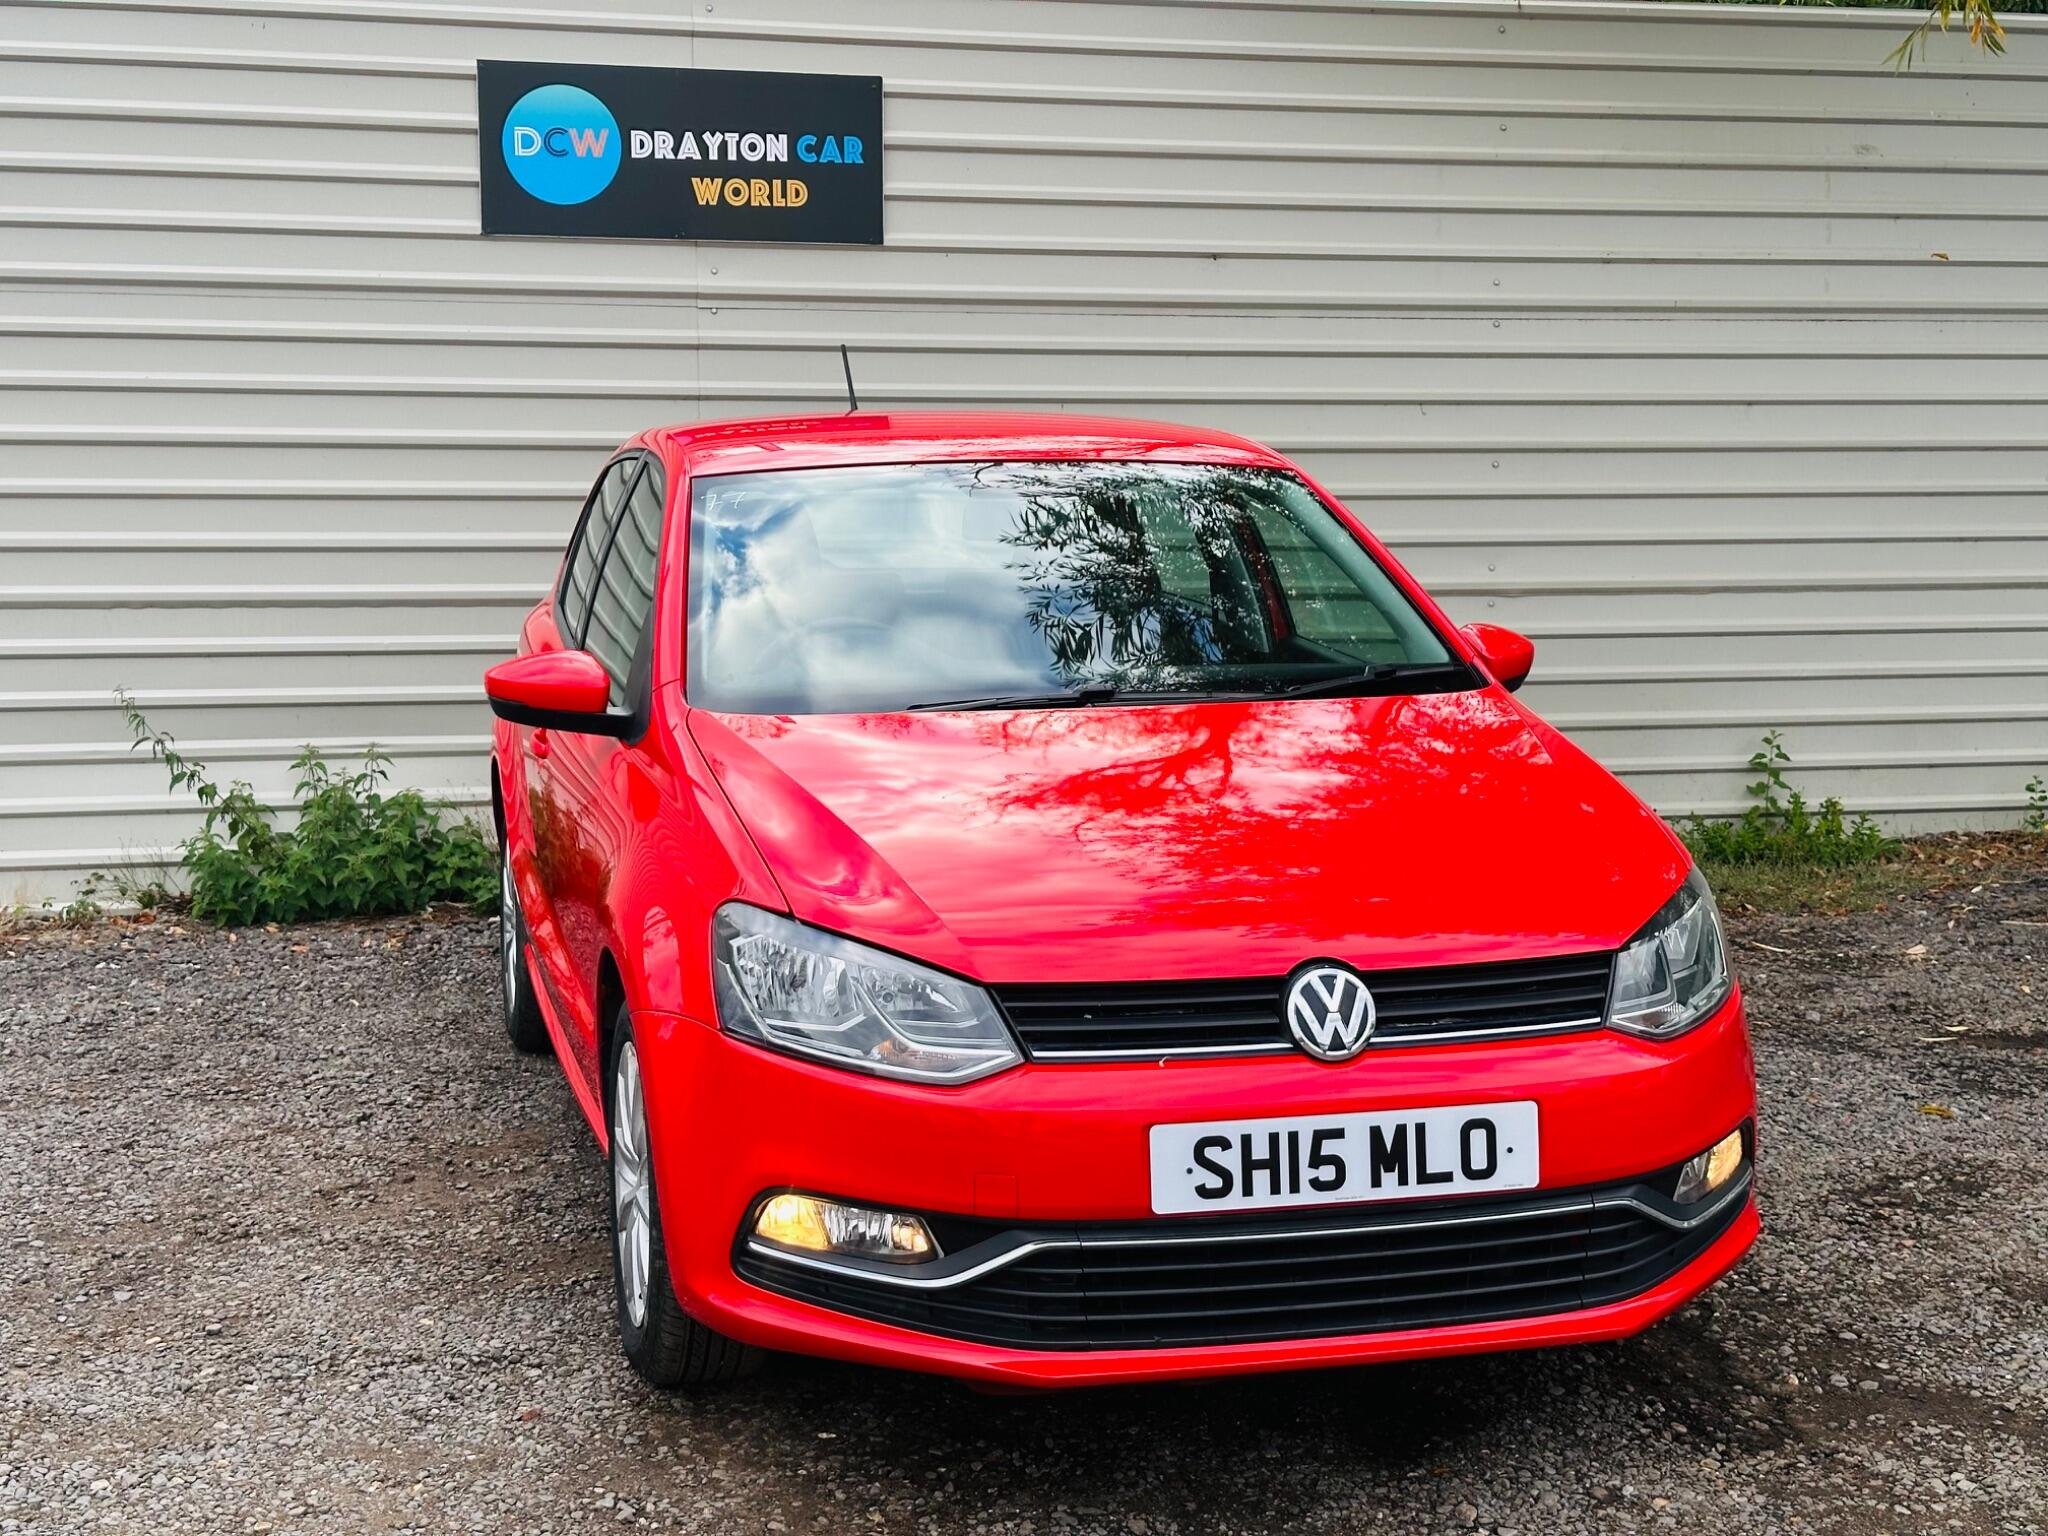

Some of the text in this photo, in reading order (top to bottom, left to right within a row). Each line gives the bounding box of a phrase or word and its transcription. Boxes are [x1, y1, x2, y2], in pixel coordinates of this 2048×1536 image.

[514, 126, 609, 158] DCW
[630, 130, 864, 164] DRAYTON CAR
[691, 177, 809, 208] WORLD
[1369, 1117, 1497, 1189] MLO
